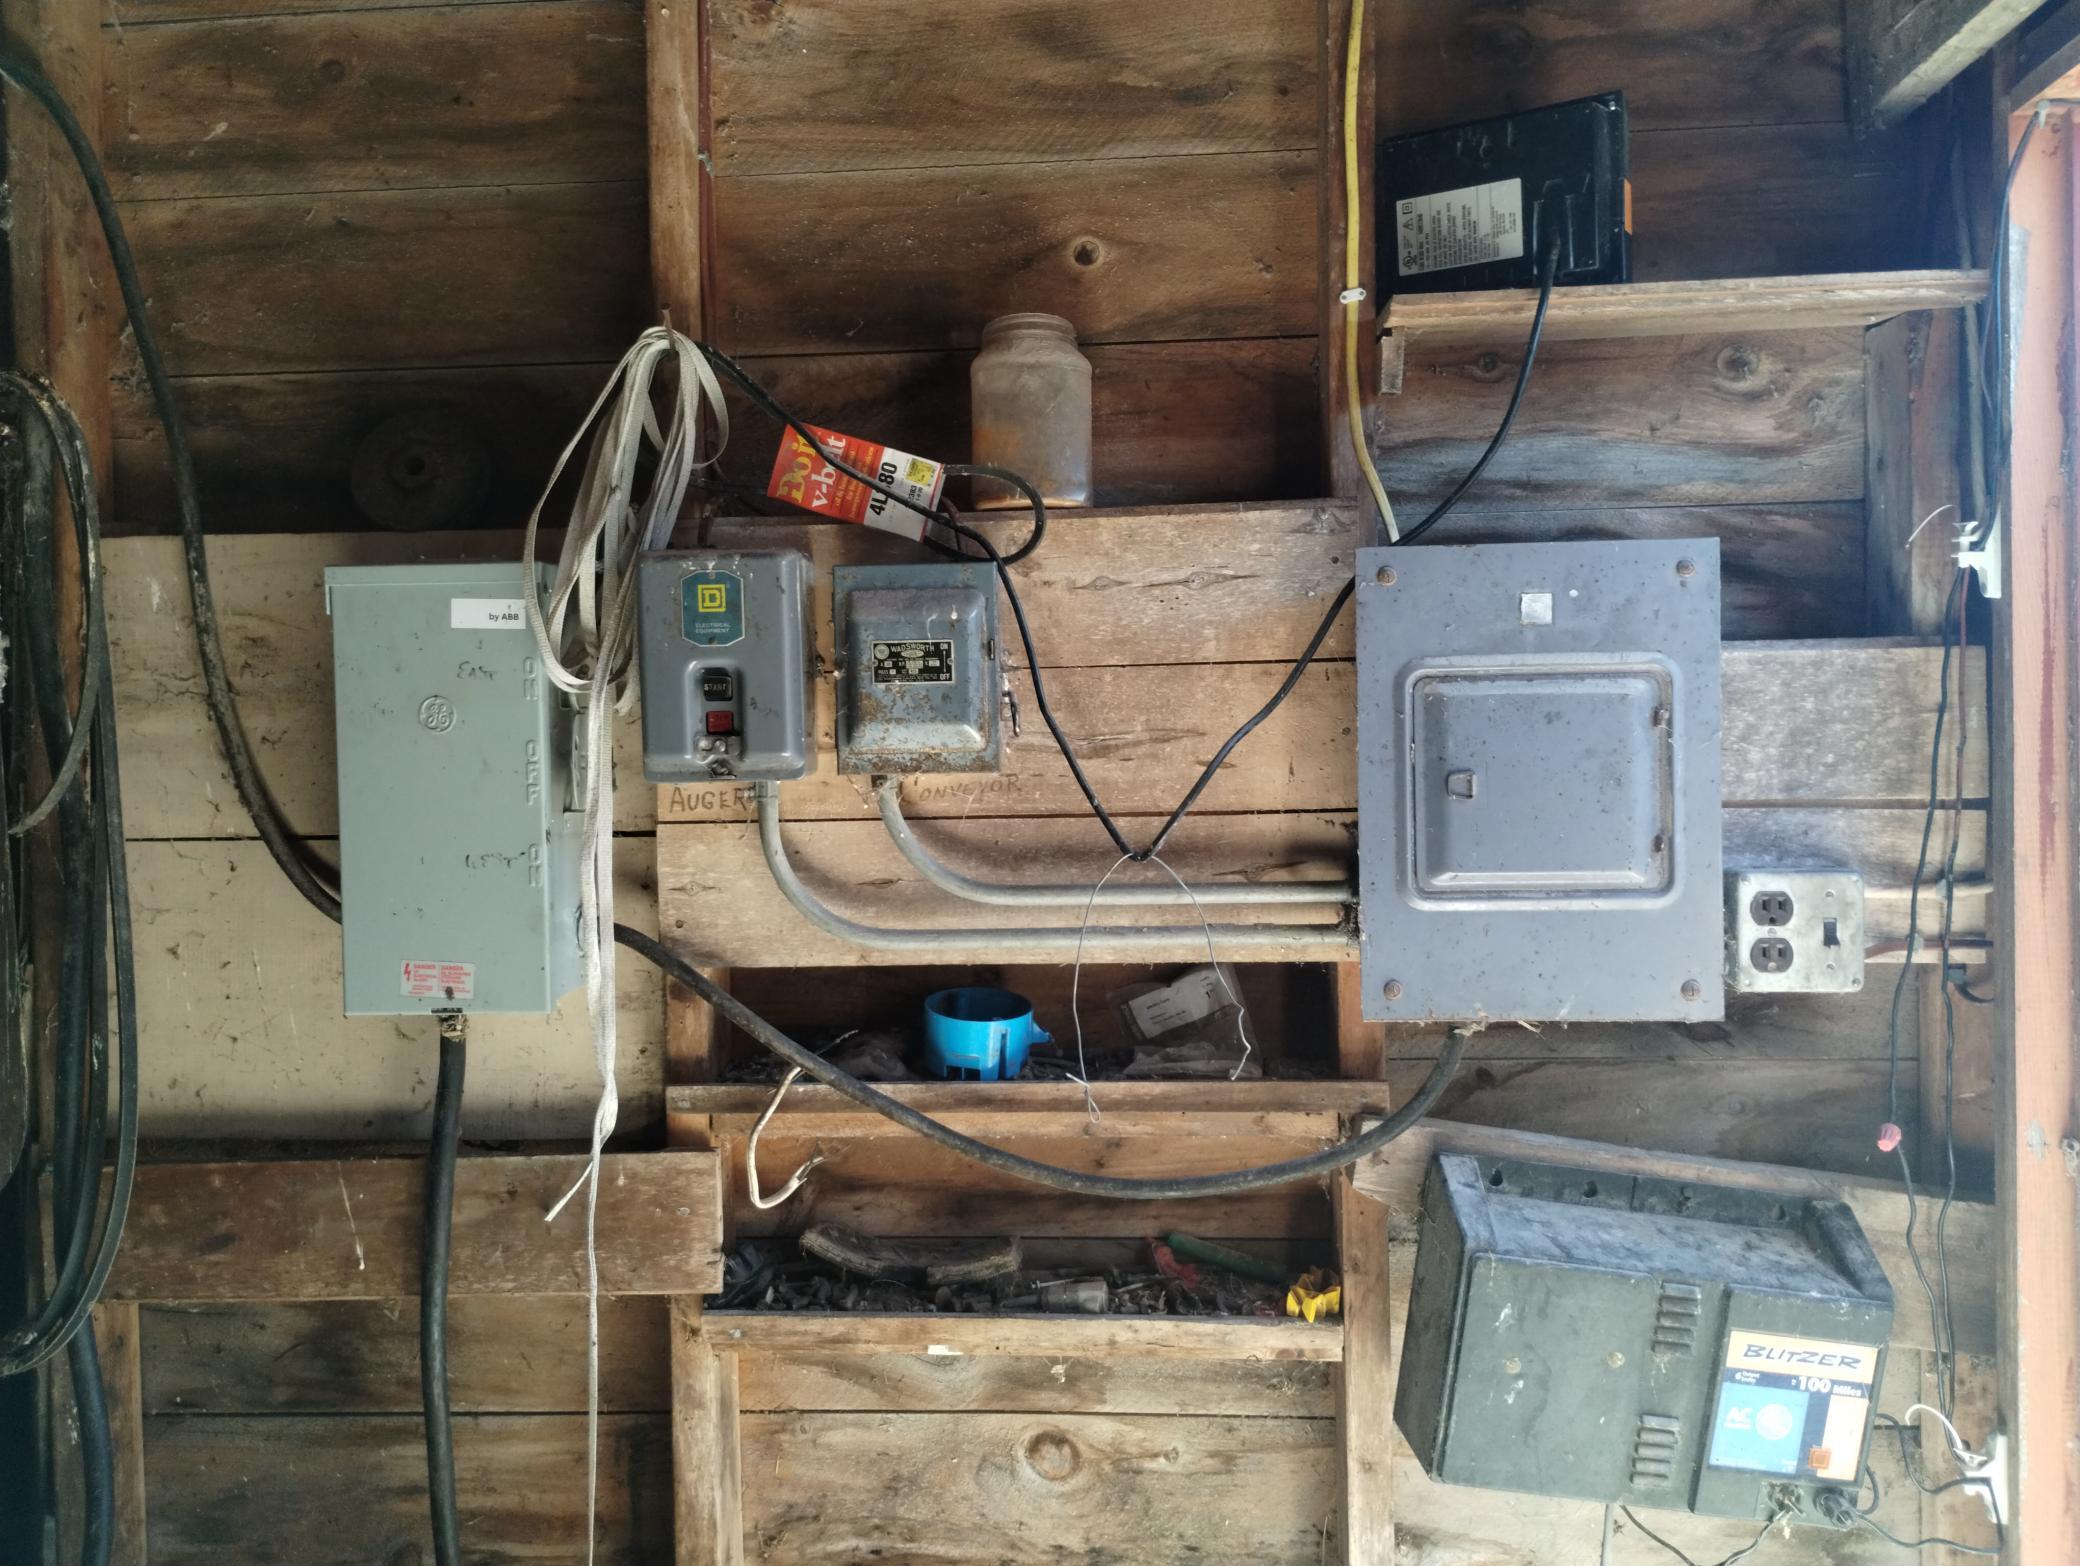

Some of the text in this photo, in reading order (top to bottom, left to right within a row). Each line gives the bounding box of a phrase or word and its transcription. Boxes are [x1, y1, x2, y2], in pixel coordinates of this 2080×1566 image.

[776, 456, 811, 504] Do
[811, 435, 846, 508] v-blt
[868, 461, 898, 517] 4L80
[488, 612, 520, 622] by ABB
[890, 642, 935, 653] WADSWORTH
[939, 642, 949, 650] ON
[703, 683, 727, 691] START
[939, 673, 951, 681] OFF
[669, 786, 748, 813] AUGER
[1743, 1343, 1862, 1370] BLITZER
[1799, 1375, 1832, 1393] 100
[1832, 1384, 1862, 1398] Miles
